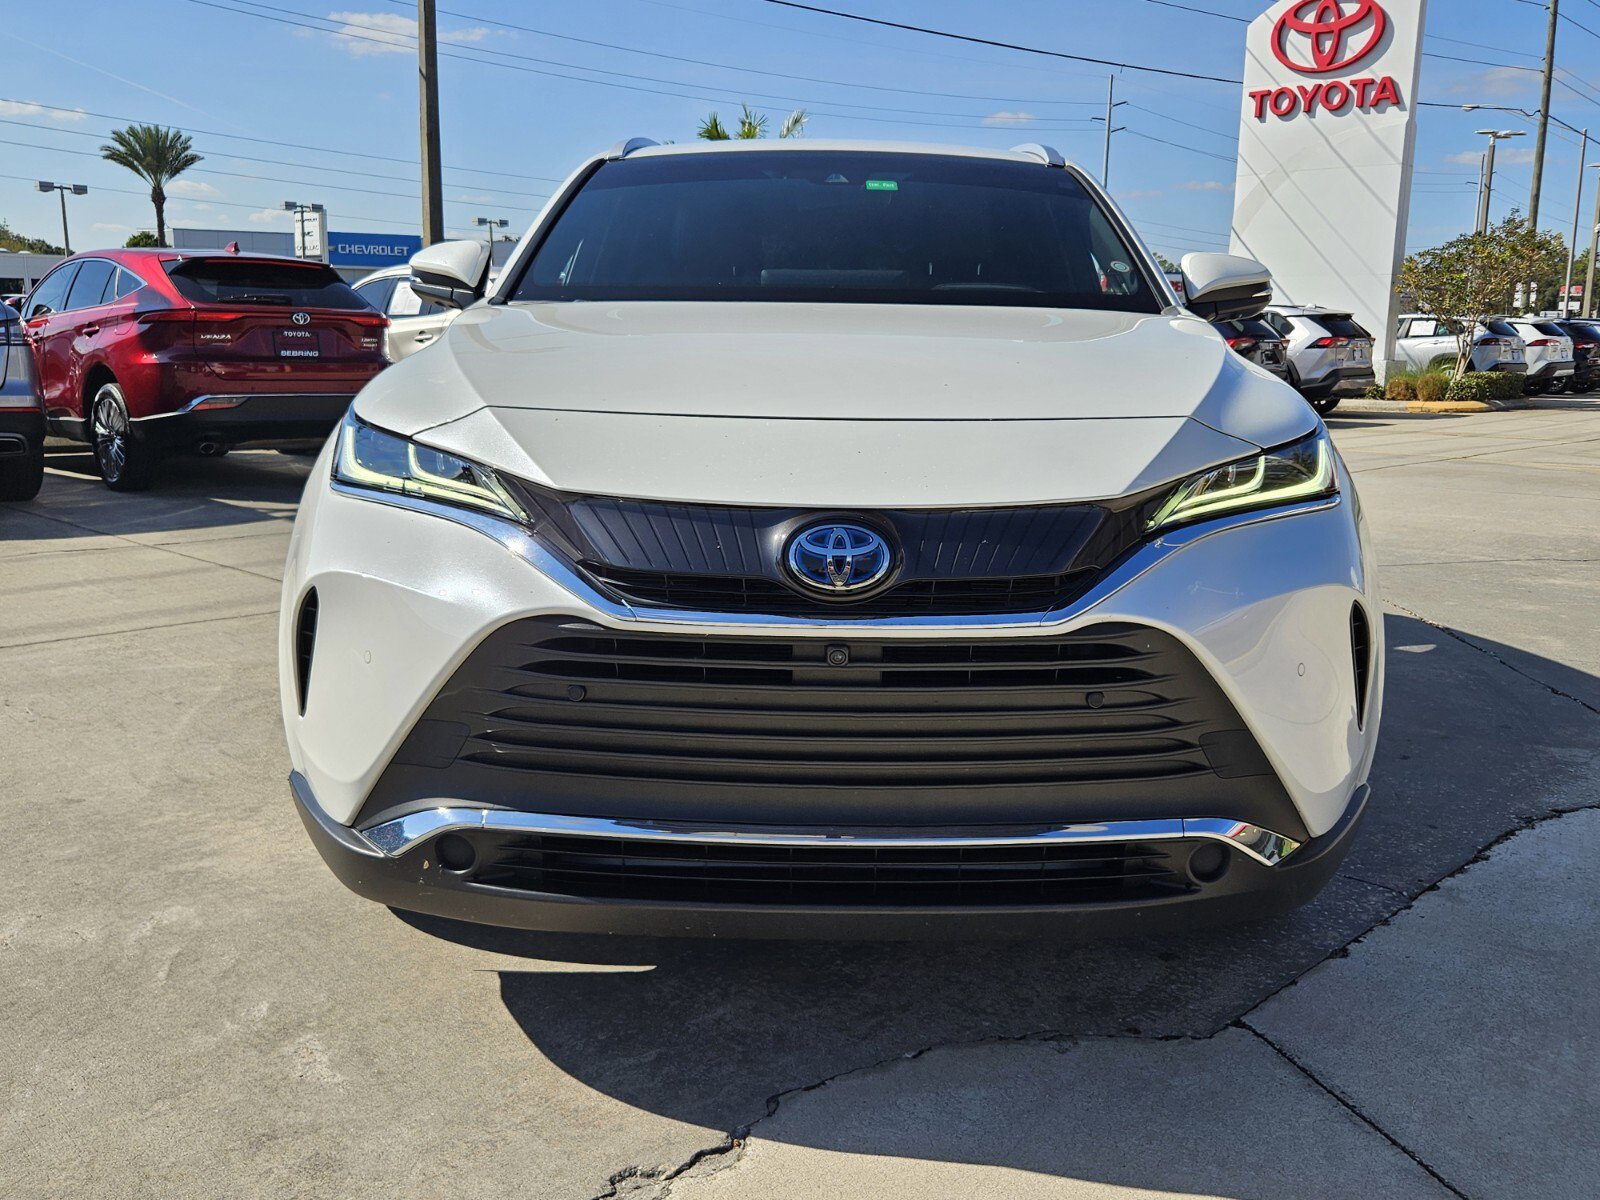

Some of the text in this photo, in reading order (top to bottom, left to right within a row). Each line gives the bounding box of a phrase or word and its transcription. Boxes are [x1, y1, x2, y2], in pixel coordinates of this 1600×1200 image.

[1249, 76, 1400, 118] TOYOTA
[338, 243, 410, 256] CHEVROLET
[283, 330, 311, 338] TOYOTA
